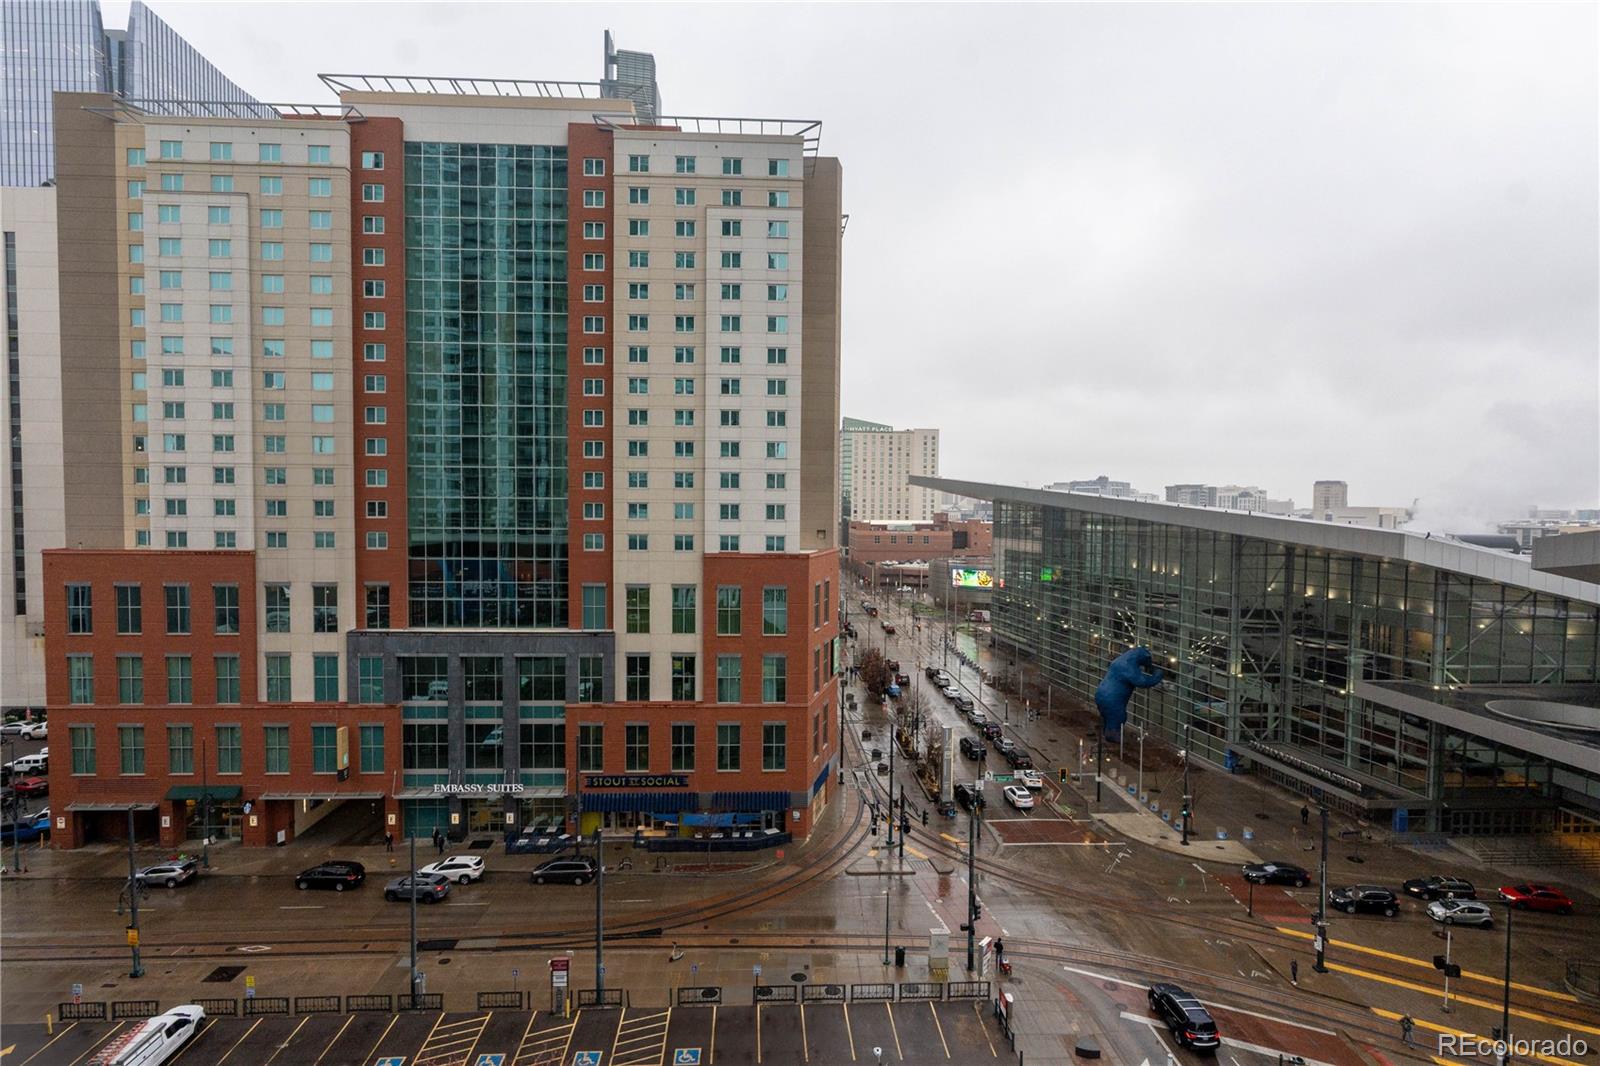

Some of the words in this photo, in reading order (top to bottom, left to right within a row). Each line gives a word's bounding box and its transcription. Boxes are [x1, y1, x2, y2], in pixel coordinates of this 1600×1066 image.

[593, 777, 625, 786] STOUT
[641, 776, 680, 786] SOCIAL
[433, 783, 484, 793] EMBASSY
[487, 783, 524, 792] SUITES
